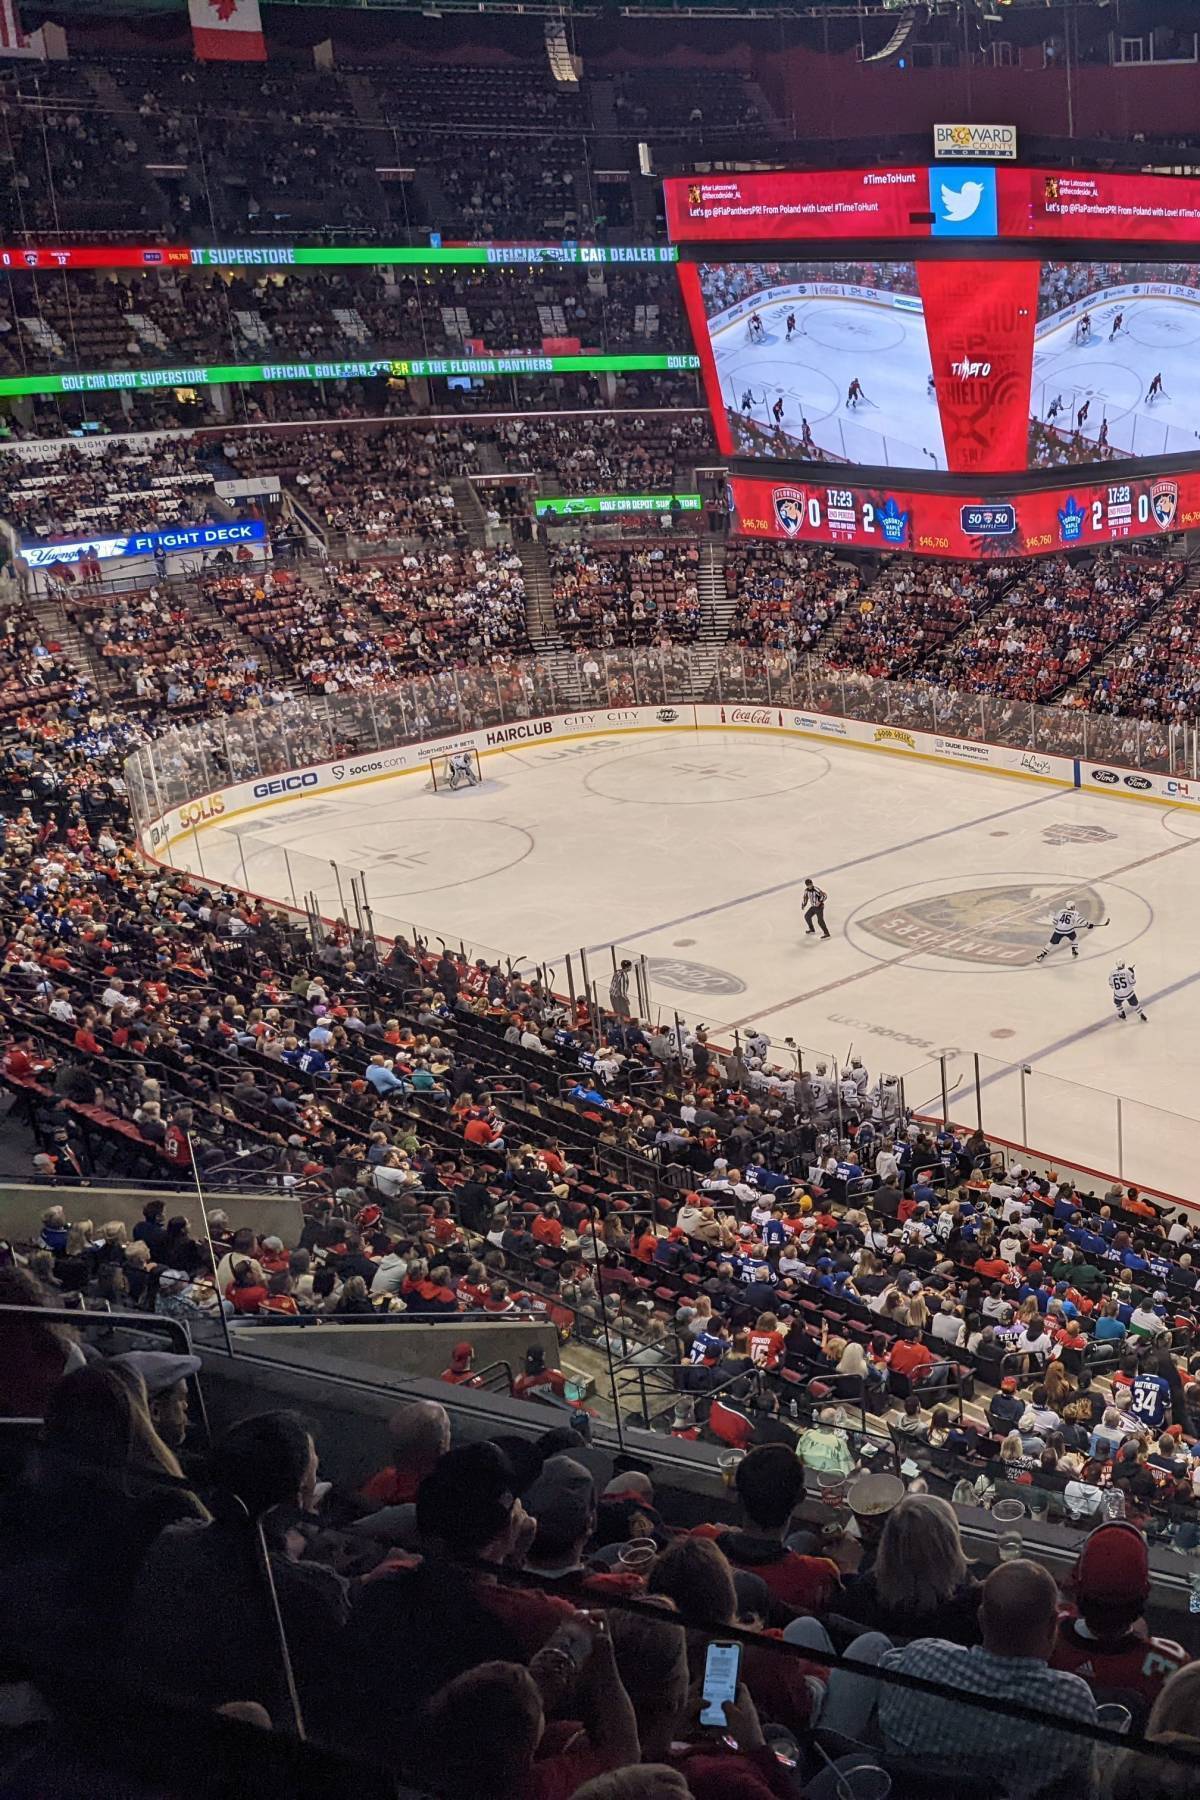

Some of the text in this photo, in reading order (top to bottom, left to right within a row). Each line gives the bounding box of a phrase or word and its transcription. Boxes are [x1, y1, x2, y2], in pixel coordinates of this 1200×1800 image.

[972, 142, 1013, 150] COUNTY
[863, 173, 915, 184] #TimeToHunt
[690, 202, 878, 217] Let's go From Poland with Love! #TimeToHunt
[1045, 203, 1060, 212] Let's
[1061, 206, 1068, 214] go
[1117, 206, 1132, 215] From
[1133, 206, 1151, 216] Poland
[1152, 207, 1163, 216] with
[1164, 207, 1179, 217] Love!
[209, 248, 294, 264] SUPERSTORE
[581, 246, 674, 262] CAR DEALER OF
[263, 366, 312, 379] OFFICIAL
[412, 361, 425, 374] OF
[428, 361, 447, 374] THE
[451, 359, 495, 373] FLORIDA
[498, 358, 553, 372] PANTHERS
[667, 355, 688, 369] GOLF
[62, 370, 208, 391] GOLF CAR DEPOT SUPERSTORE
[827, 490, 852, 507] 17:23
[1108, 486, 1130, 504] 17:23
[600, 500, 654, 512] GOLF CAR DEPOT
[808, 498, 821, 527] 0
[1138, 494, 1148, 523] 0
[863, 503, 875, 533] 2
[883, 517, 903, 527] TORONTO
[968, 513, 1008, 524] 50 50
[1062, 516, 1081, 526] TORONTO
[1092, 501, 1103, 531] 2
[742, 519, 768, 530] $46,760
[205, 525, 251, 542] DECK
[1026, 534, 1052, 548] $46,760
[919, 536, 949, 548] $46,760
[564, 714, 596, 727] CITY
[607, 711, 640, 722] CITY
[657, 710, 679, 719] NHL
[486, 721, 553, 746] HAIRCLUB
[945, 741, 989, 755] DUDE PERFECT
[253, 772, 318, 798] GEICO
[1096, 772, 1148, 788] Ford Ford
[1168, 781, 1188, 795] CH
[180, 794, 225, 829] SOLIS
[1059, 913, 1072, 925] 46
[1113, 975, 1127, 990] 65
[1135, 1381, 1160, 1392] MATTHEWS
[1132, 1390, 1158, 1416] 34
